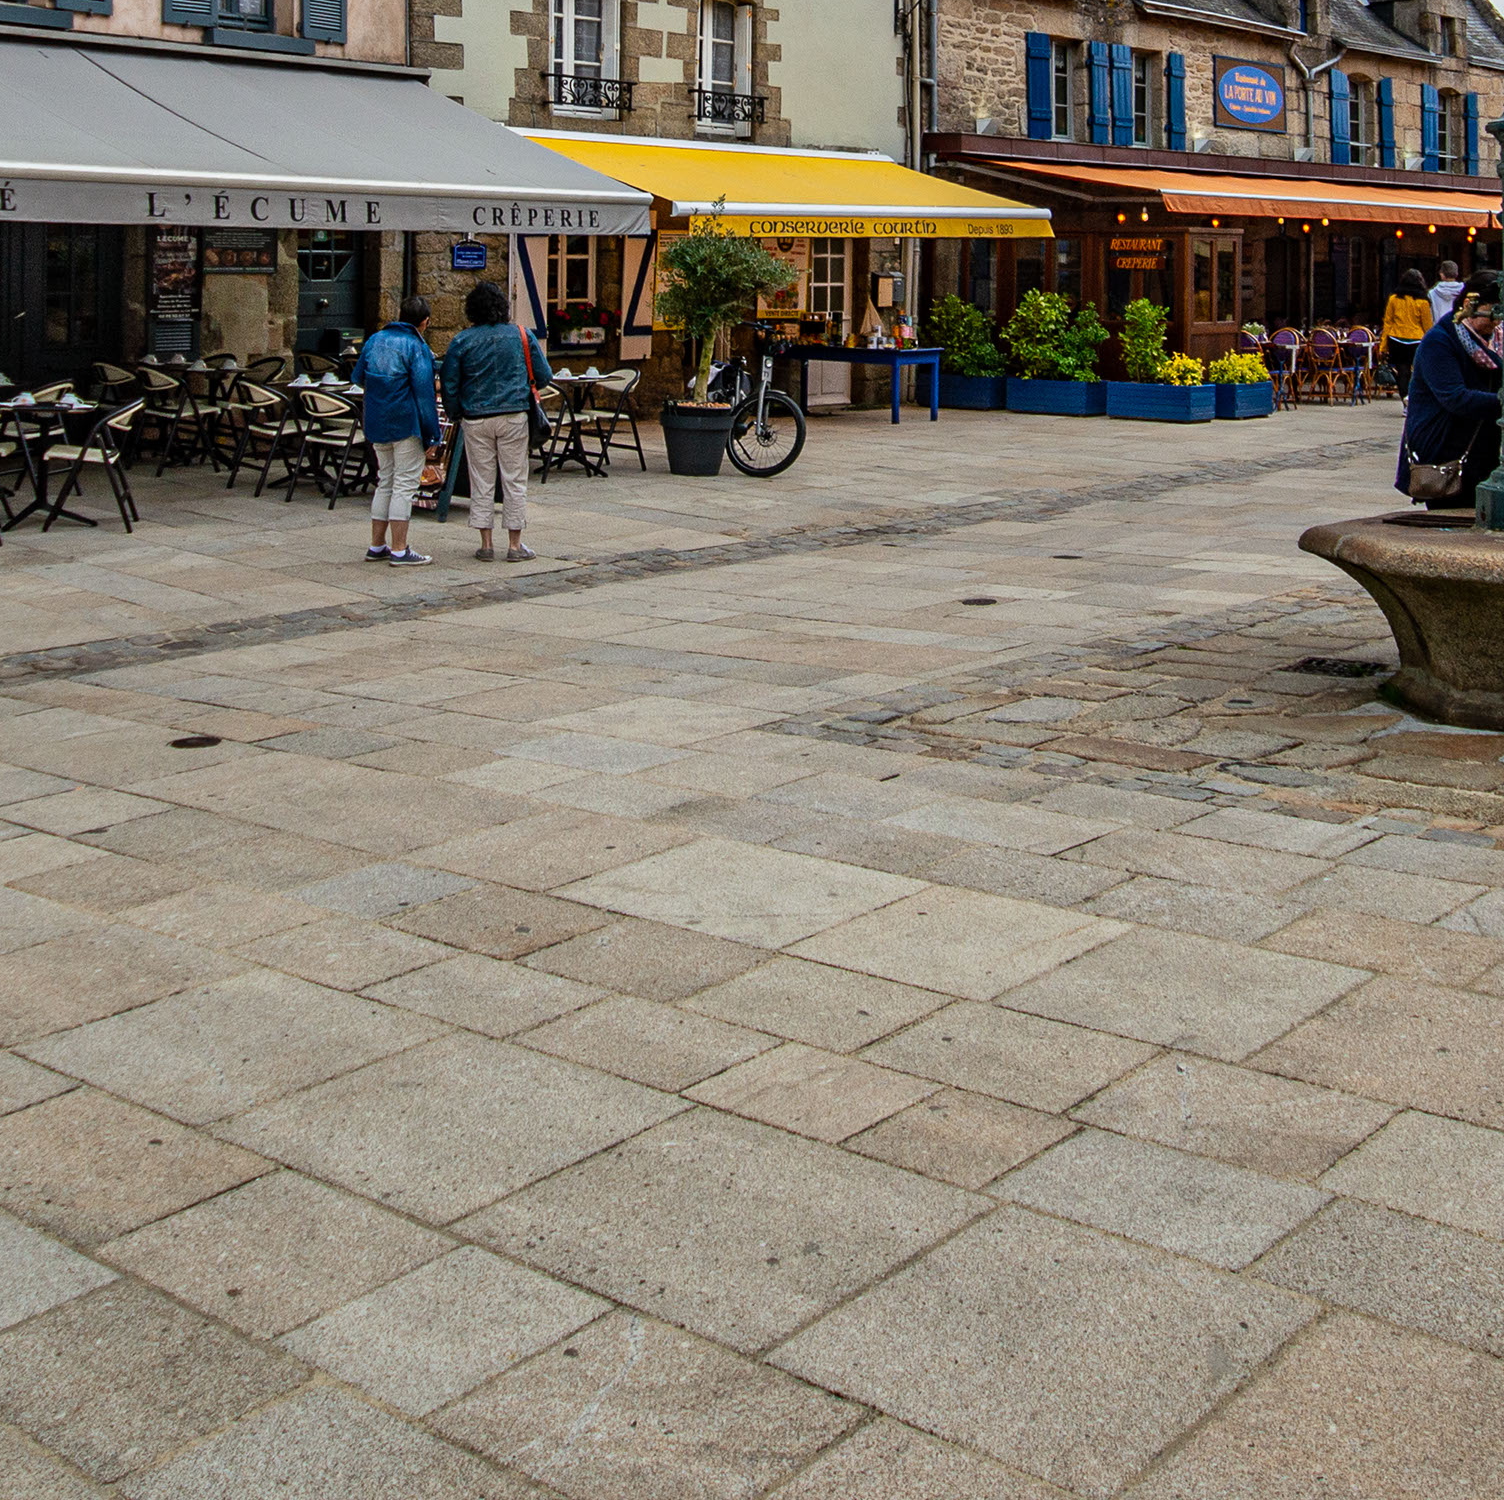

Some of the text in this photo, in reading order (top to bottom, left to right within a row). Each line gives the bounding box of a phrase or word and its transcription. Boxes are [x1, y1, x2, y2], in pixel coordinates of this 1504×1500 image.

[146, 190, 382, 224] L'ÉCUME
[472, 202, 600, 228] CRÊPERIE
[968, 223, 1014, 236] Depuis 1893
[1110, 238, 1163, 251] RESTAURANT
